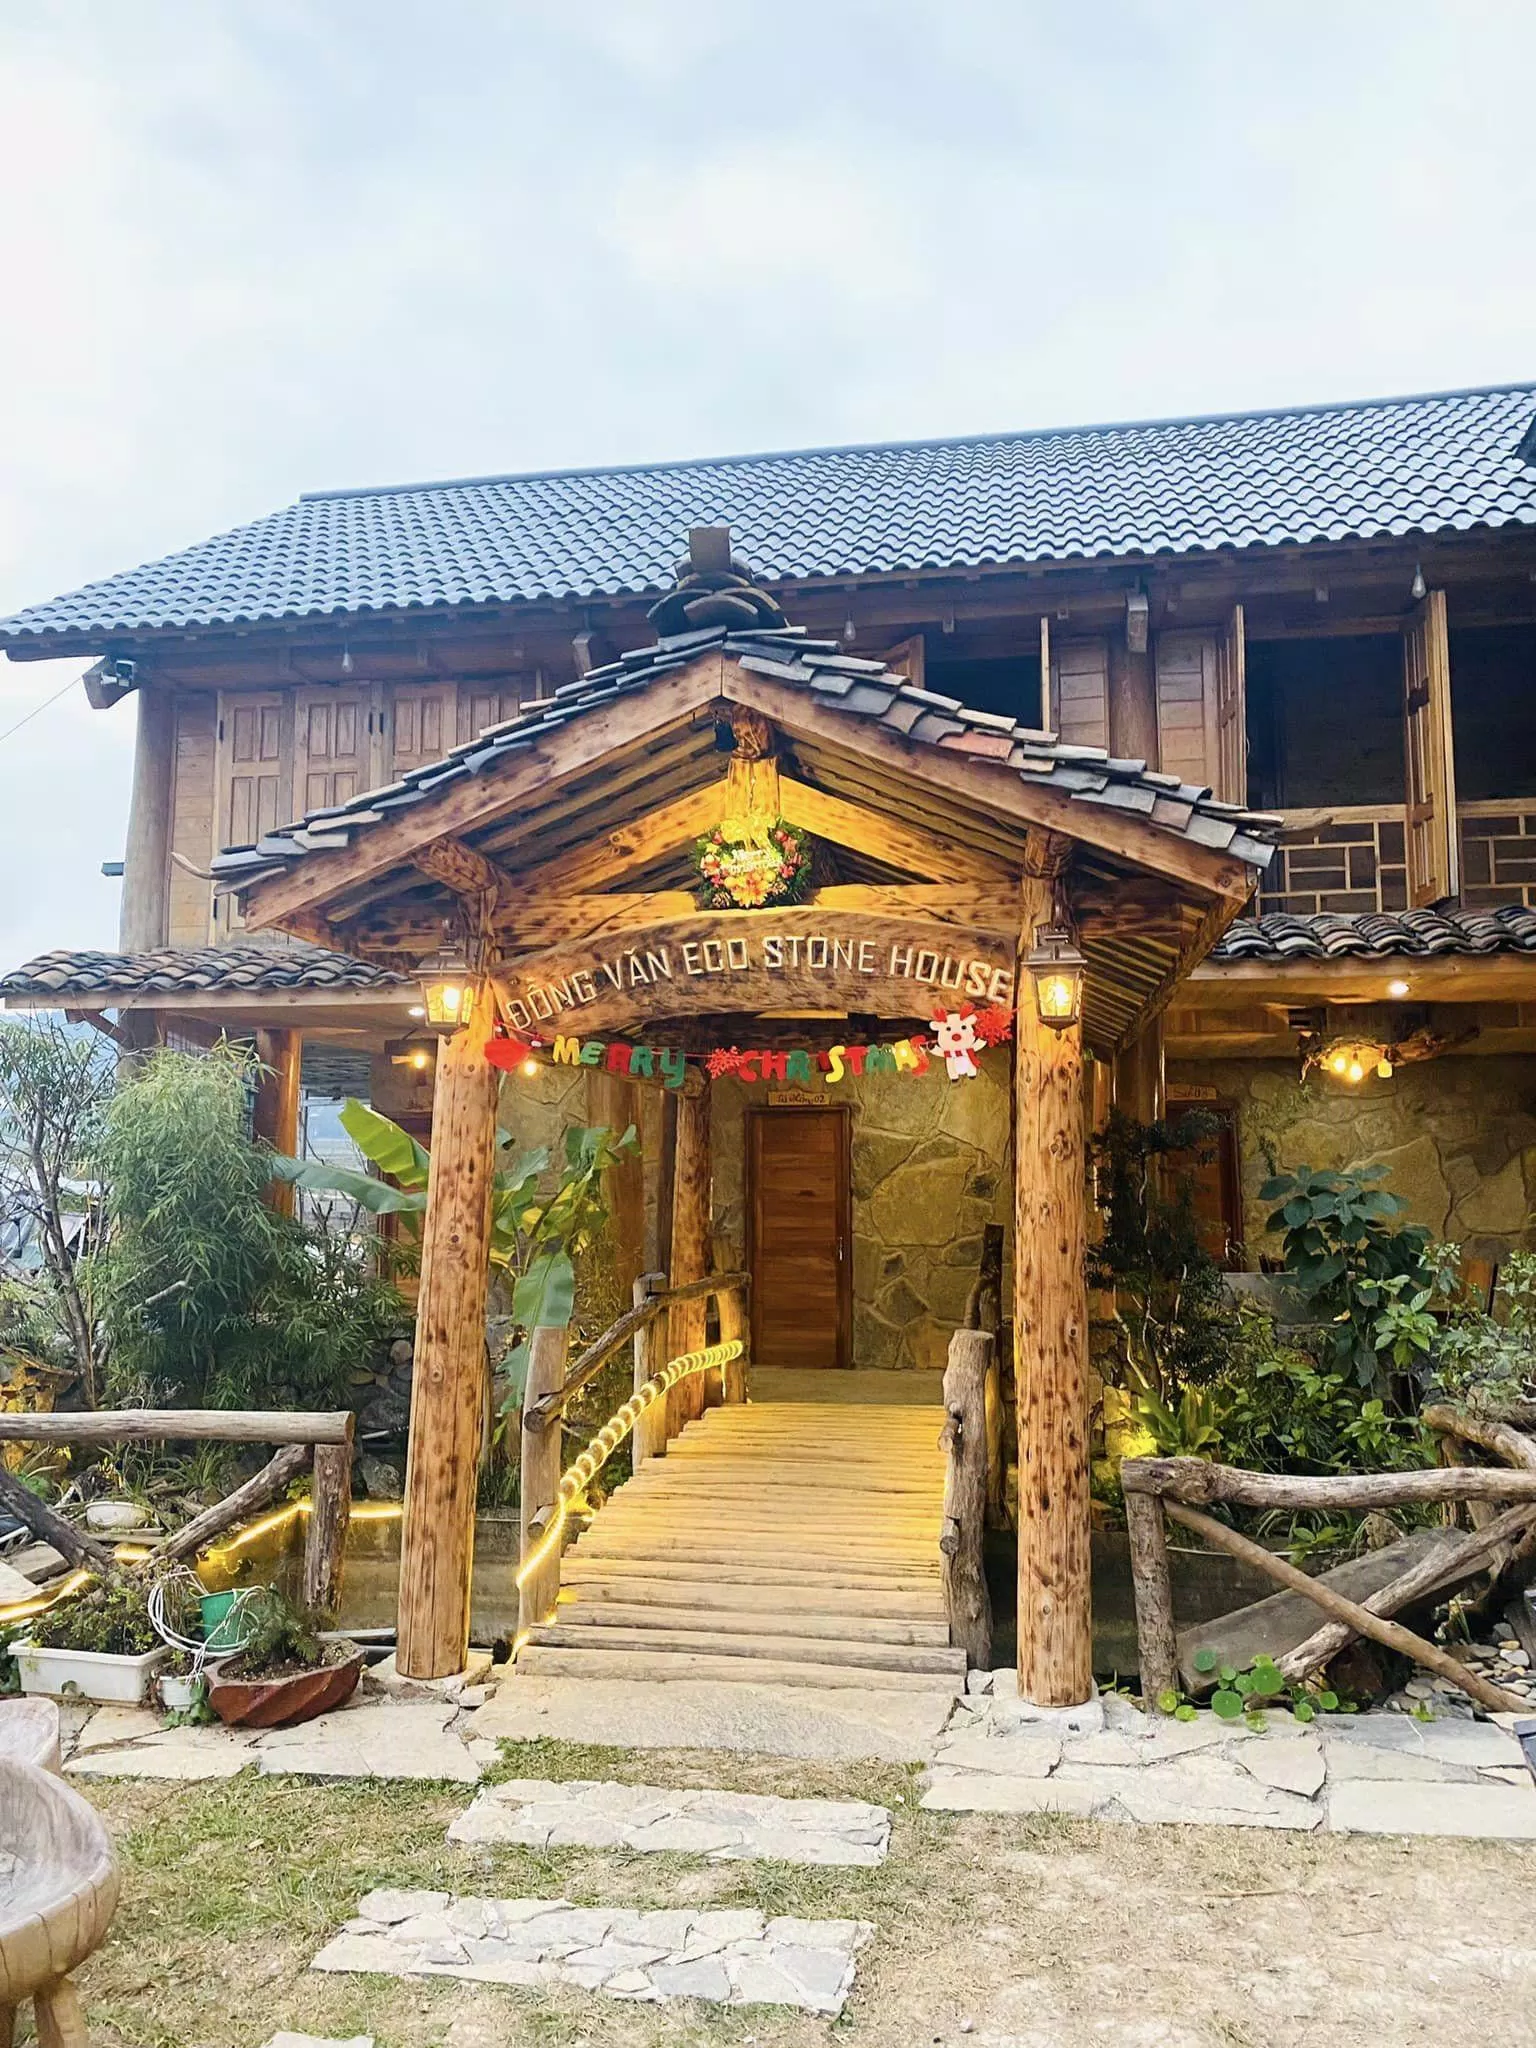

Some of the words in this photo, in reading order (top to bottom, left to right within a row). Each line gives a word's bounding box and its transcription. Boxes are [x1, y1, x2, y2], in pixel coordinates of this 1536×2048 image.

[602, 947, 673, 991] VĂN
[682, 937, 749, 976] ECO
[762, 935, 876, 973] STONE
[889, 945, 1013, 1004] HOUSE
[738, 1034, 930, 1083] CHRISTMAS
